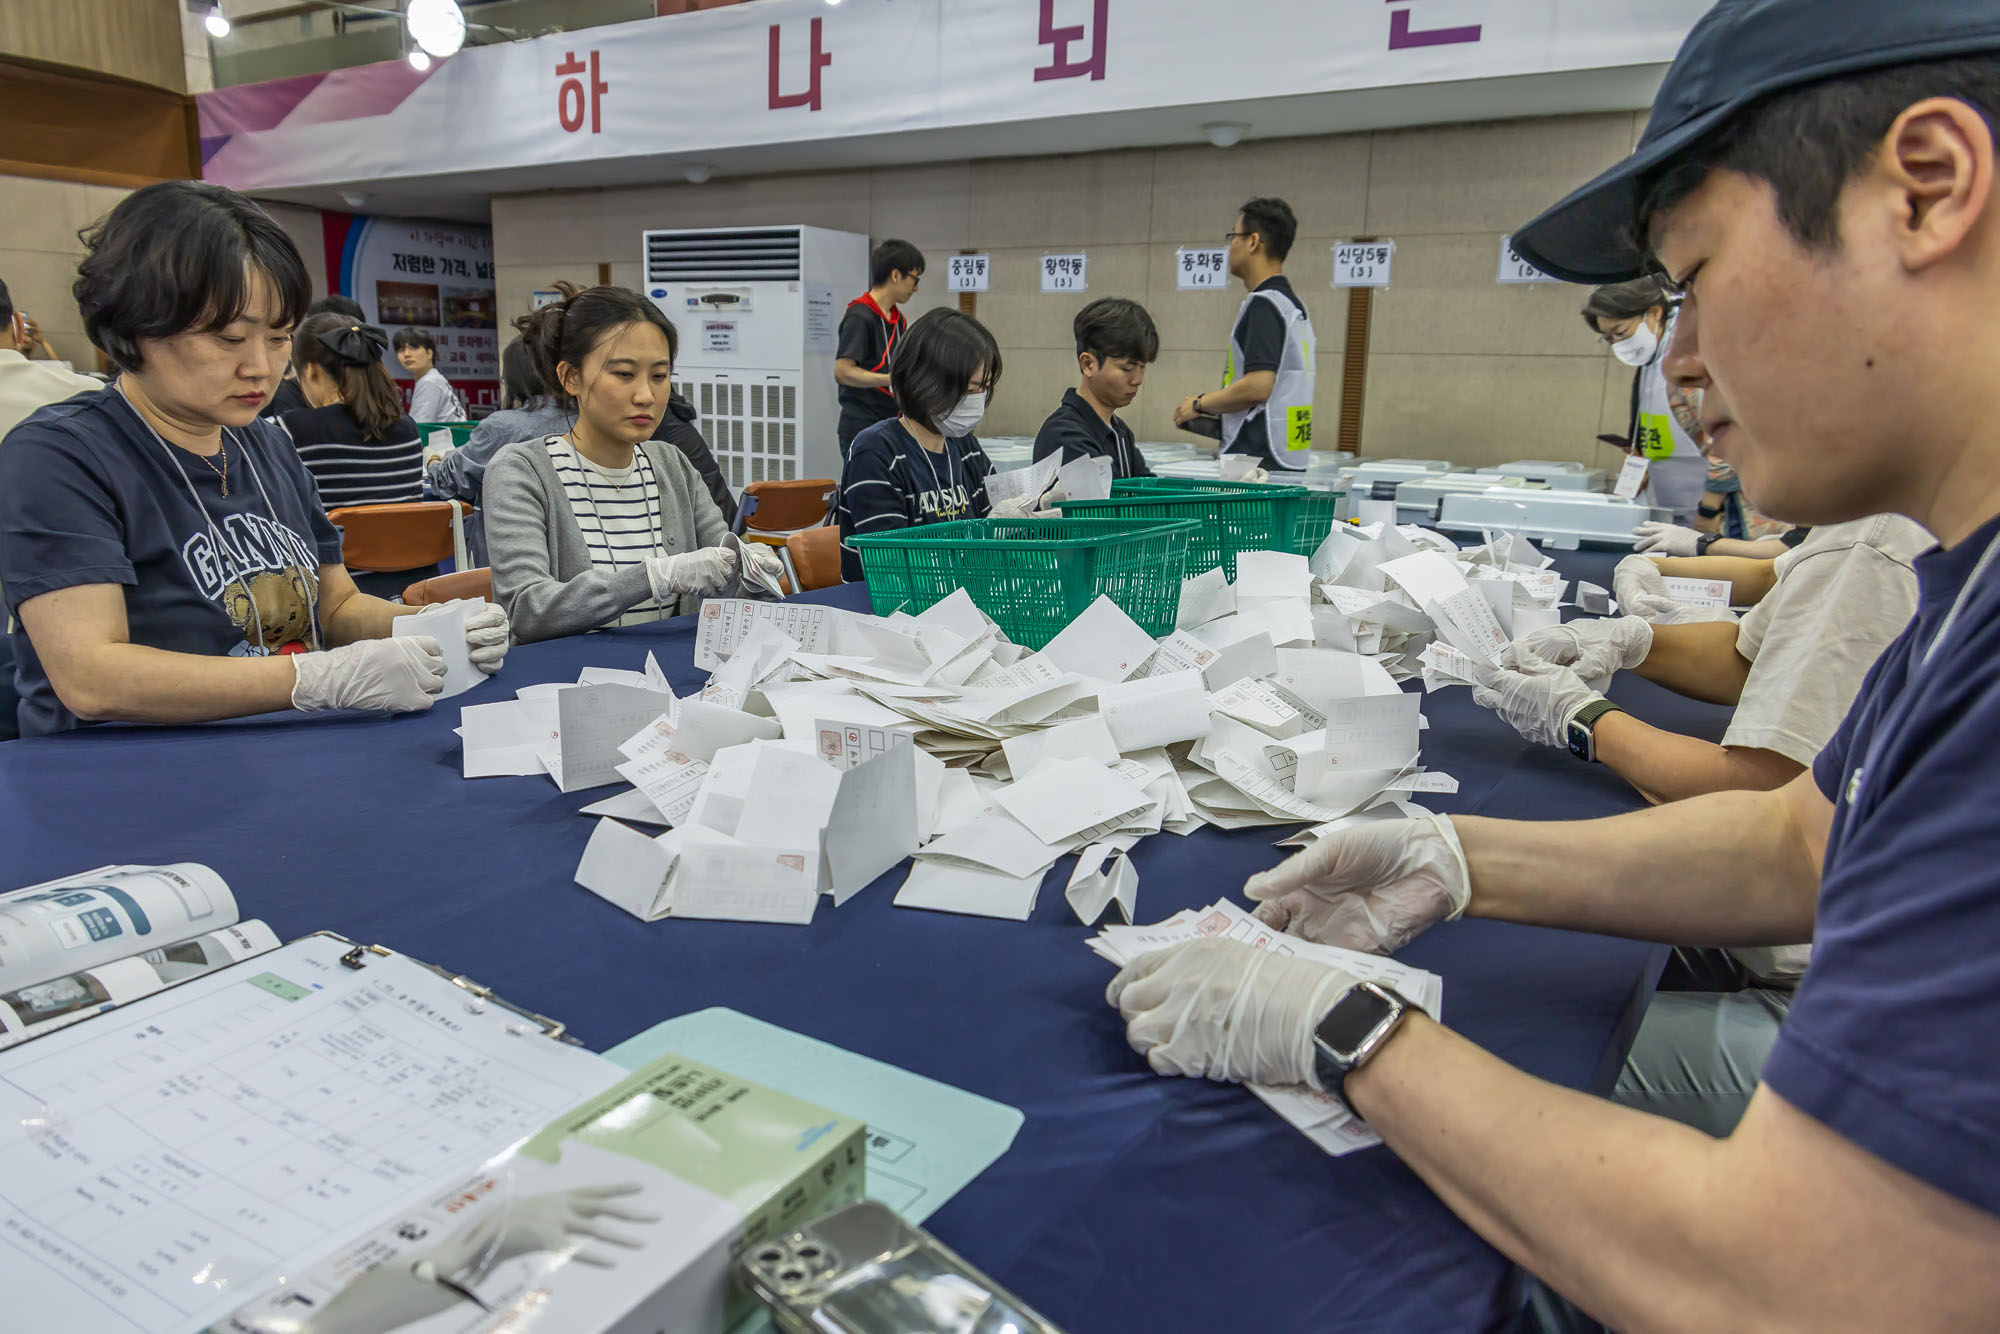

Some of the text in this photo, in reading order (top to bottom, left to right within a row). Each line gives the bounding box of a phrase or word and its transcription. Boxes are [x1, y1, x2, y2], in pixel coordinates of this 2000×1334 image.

[1182, 253, 1224, 271] 동화동
[1338, 247, 1388, 264] 신당5동
[391, 252, 436, 274] 저렴한
[439, 256, 471, 278] 가격,
[952, 259, 986, 276] 중림동
[1045, 258, 1082, 276] 황학동
[1350, 266, 1373, 279] (3)
[960, 277, 976, 288] (3)
[1054, 277, 1073, 288] (3)
[1192, 273, 1212, 285] (4)
